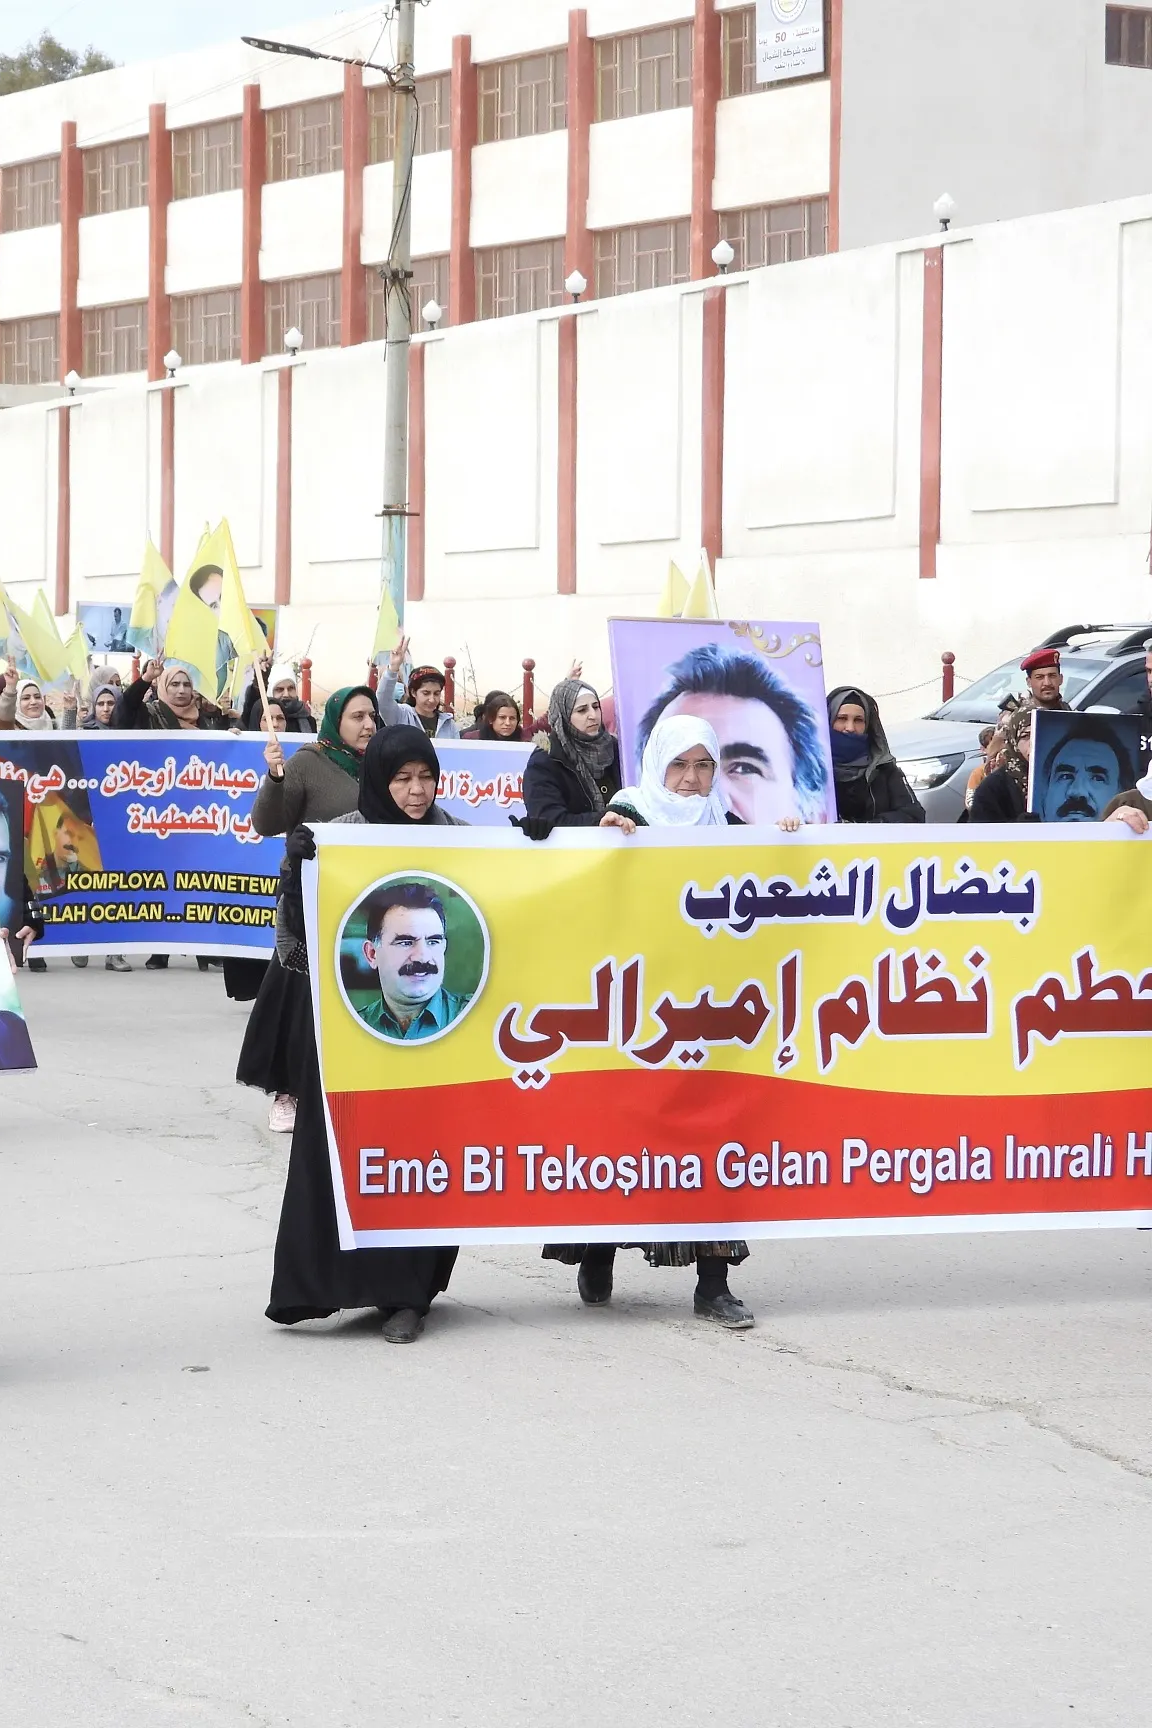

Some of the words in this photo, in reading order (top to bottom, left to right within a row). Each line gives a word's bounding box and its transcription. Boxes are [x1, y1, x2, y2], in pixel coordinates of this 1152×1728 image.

[774, 31, 787, 43] 50
[29, 766, 63, 801] هي
[101, 759, 175, 795] أوجلان
[128, 804, 228, 837] المضطهدة
[67, 872, 166, 890] KOMPLOYA
[176, 872, 280, 895] NAVNETEW
[683, 861, 875, 934] الشعوب
[884, 861, 1036, 930] بنضال
[39, 905, 86, 922] LLAH
[90, 903, 162, 922] OCALAN
[186, 904, 214, 921] EW
[497, 953, 798, 1084] إميرالي
[817, 950, 988, 1071] نظام
[358, 1147, 448, 1194] Emê
[462, 1145, 504, 1192] Bi
[517, 1144, 702, 1196] Tekoşîna
[716, 1140, 828, 1188] Gelan
[842, 1135, 992, 1194] Pergala
[1005, 1132, 1113, 1180] Imralî
